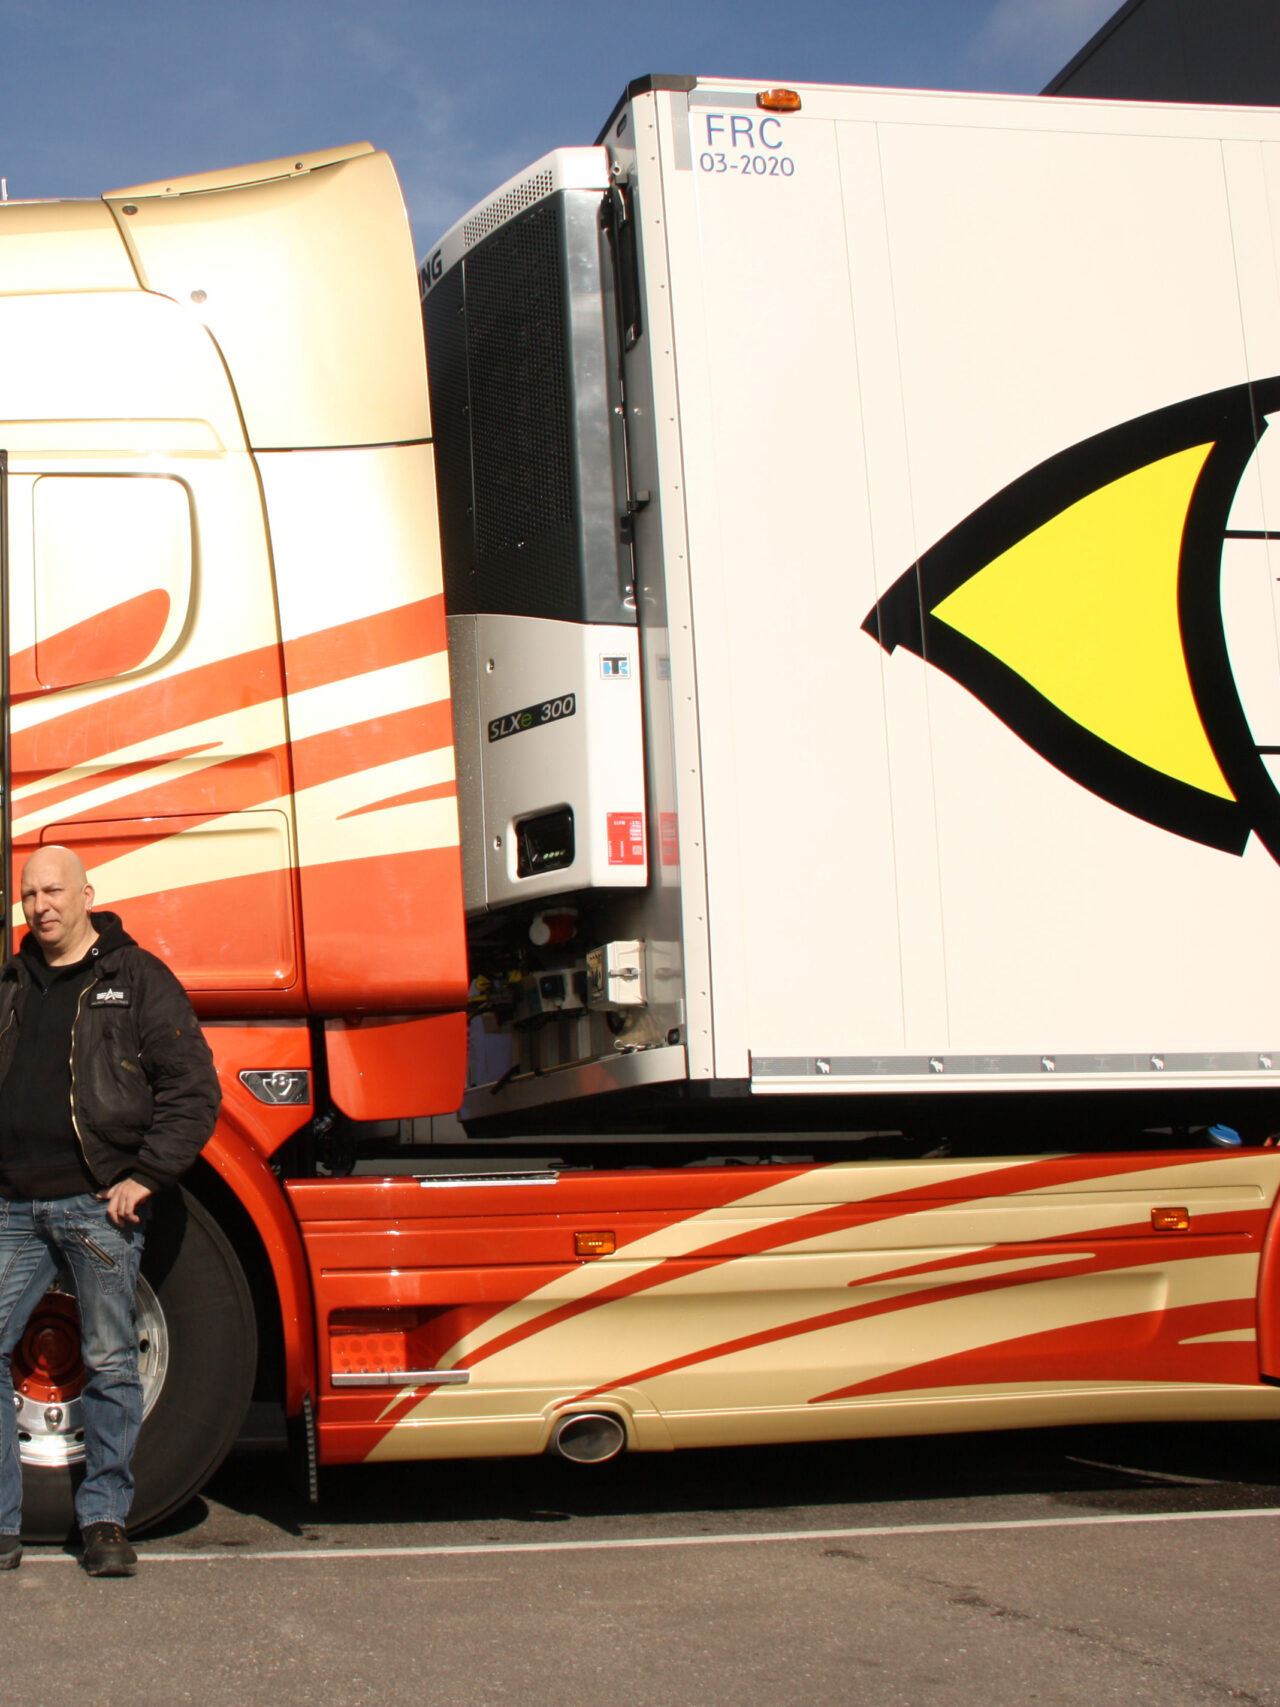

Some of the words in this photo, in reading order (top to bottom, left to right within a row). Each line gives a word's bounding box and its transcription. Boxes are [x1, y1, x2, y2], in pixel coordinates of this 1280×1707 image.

[706, 114, 783, 150] FRC
[700, 152, 795, 177] 03-2020
[421, 248, 442, 296] NG
[490, 713, 533, 740] SLXe
[540, 696, 574, 722] 300
